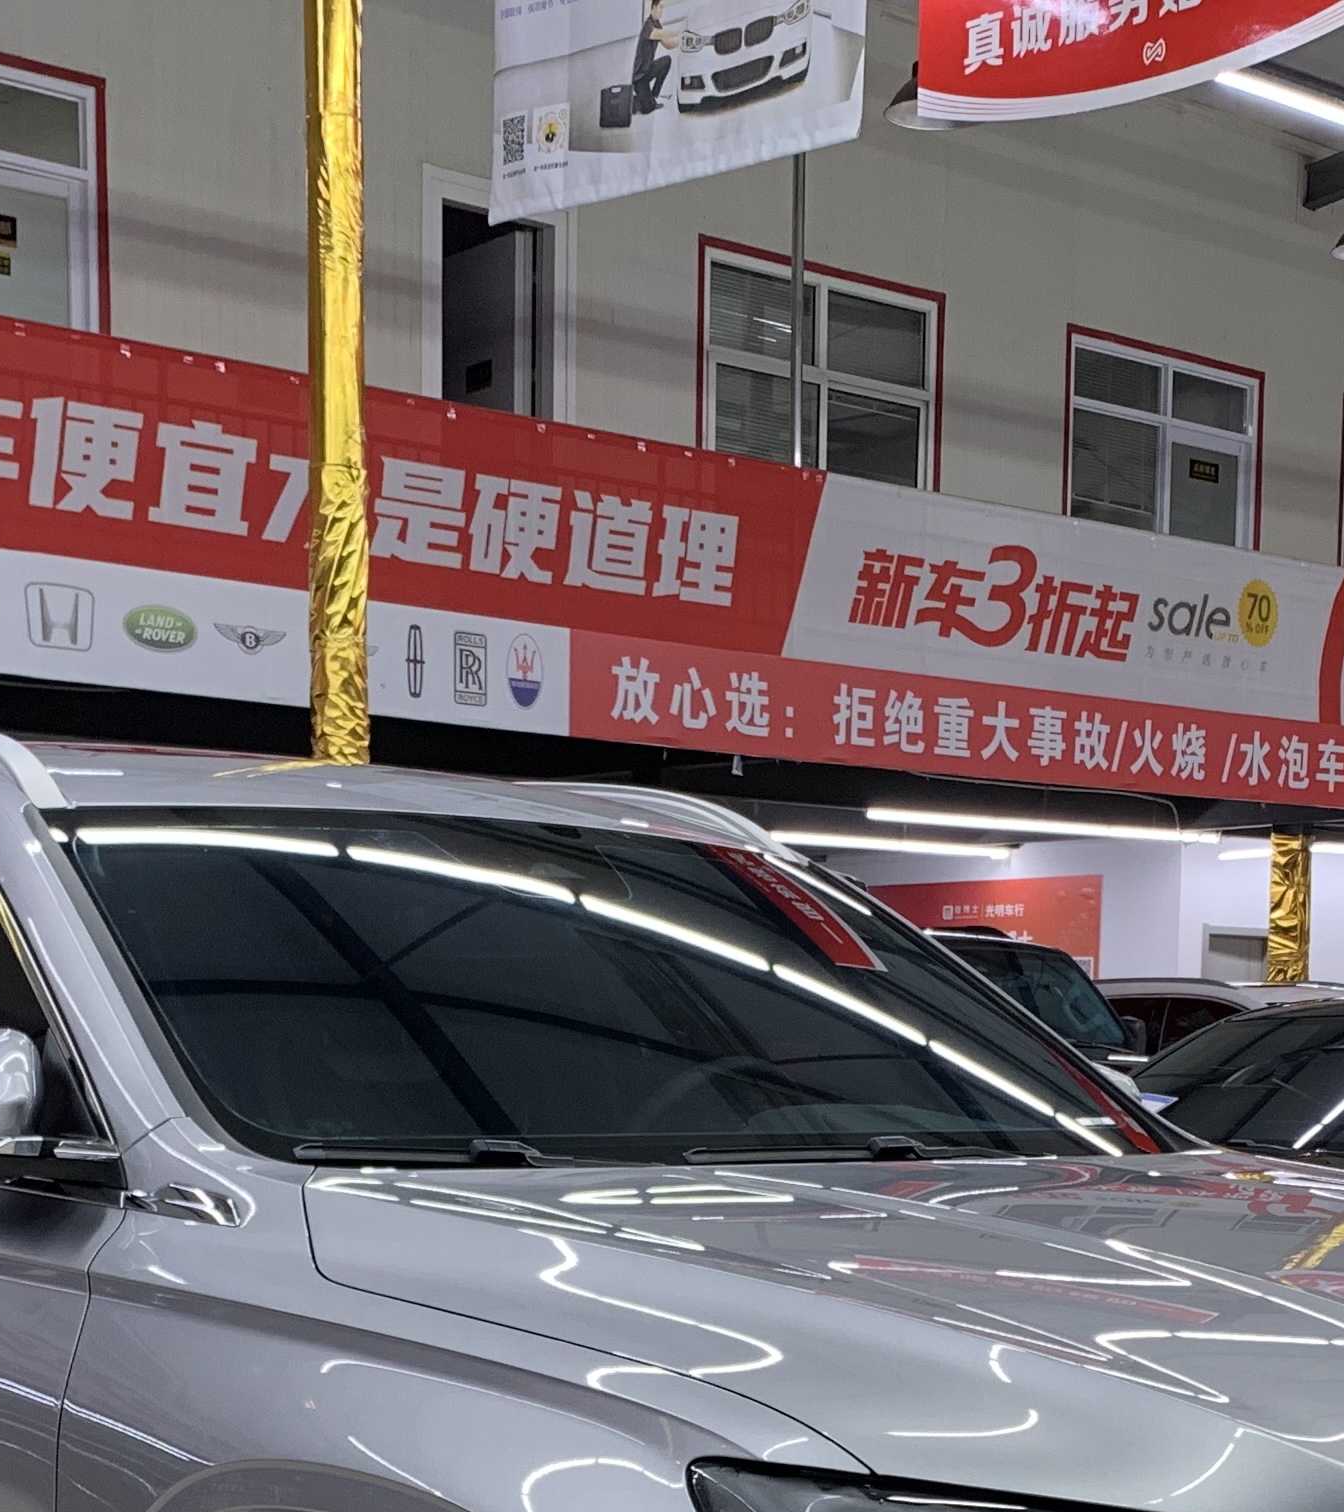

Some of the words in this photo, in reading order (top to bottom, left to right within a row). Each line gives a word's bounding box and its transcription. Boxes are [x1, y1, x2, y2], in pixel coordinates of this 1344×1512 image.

[848, 545, 1140, 662] 新车3折起
[1247, 592, 1271, 623] 70
[139, 612, 174, 630] LAND
[1148, 593, 1231, 640] sale
[142, 627, 186, 645] ROVER
[458, 635, 483, 645] ROLLS
[458, 694, 483, 703] ROYCE
[984, 903, 1025, 919] 光明车行
